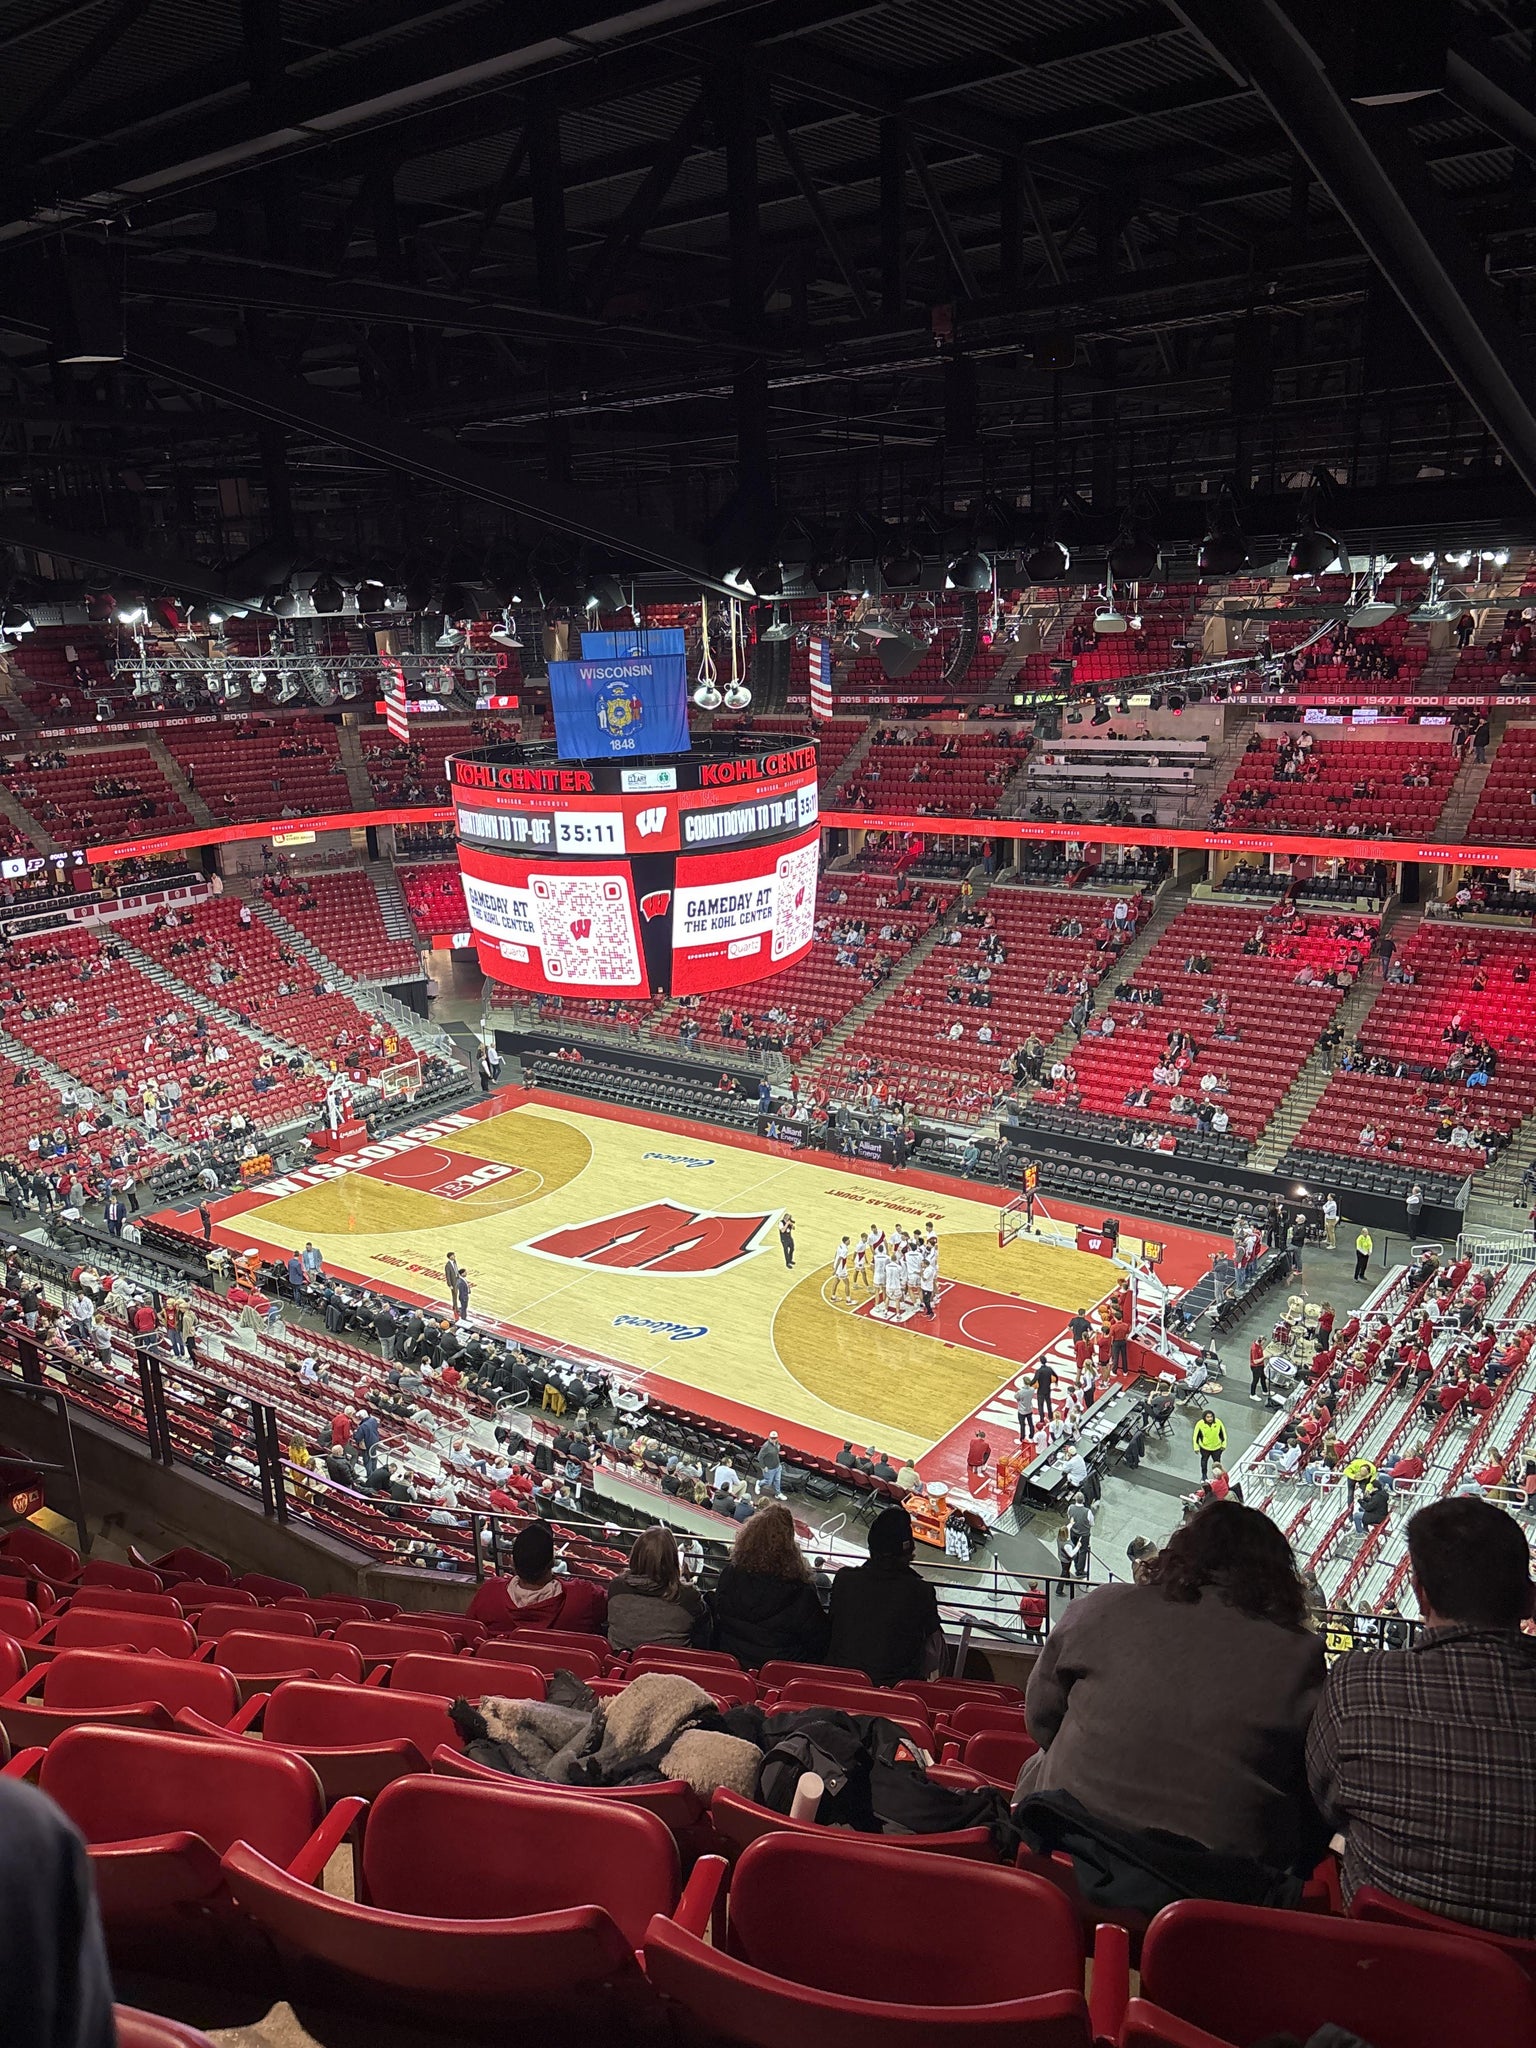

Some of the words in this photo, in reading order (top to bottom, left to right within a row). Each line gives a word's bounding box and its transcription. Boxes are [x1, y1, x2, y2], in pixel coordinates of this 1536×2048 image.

[580, 665, 653, 680] WISCONSIN
[1251, 695, 1282, 704] ELITE
[1288, 695, 1297, 704] 8
[1322, 696, 1351, 705] 1941
[1363, 696, 1394, 705] 1947
[1404, 696, 1438, 705] 2000
[1448, 696, 1484, 705] 2005
[1495, 696, 1531, 705] 2014
[194, 715, 218, 723] 2002
[223, 712, 249, 720] 2010
[106, 723, 130, 731] 1996
[136, 720, 160, 729] 1998
[166, 718, 188, 726] 2001
[40, 729, 66, 738] 1992
[73, 725, 98, 734] 1995
[610, 738, 636, 750] 1848
[701, 758, 763, 786] KOHL
[765, 746, 818, 775] CENTER
[456, 763, 496, 787] KOHL
[498, 768, 594, 792] CENTER
[800, 793, 817, 816] 35:11
[685, 804, 757, 842] COUNTDOWN
[757, 803, 769, 830] TO
[769, 797, 797, 828] TIP-OFF
[498, 815, 511, 841] TO
[512, 816, 550, 844] TIP-OFF
[560, 824, 615, 842] 35:11
[11, 864, 19, 872] 0
[56, 859, 65, 868] 0
[469, 887, 509, 915] GAMEDAY
[512, 901, 529, 918] AT
[687, 893, 753, 918] GAMEDAY
[756, 887, 772, 907] AT
[471, 906, 483, 921] THE
[484, 911, 502, 927] KOHL
[502, 917, 536, 934] CENTER
[684, 920, 708, 933] THE
[711, 915, 737, 930] KOHL
[739, 907, 773, 924] CENTER
[729, 940, 760, 956] Quartz
[781, 1126, 803, 1137] Alliant
[859, 1141, 882, 1152] Alliant
[251, 1113, 482, 1199] WISCONSIN
[824, 1188, 866, 1202] COURT
[865, 1198, 926, 1216] NICHOLAS
[925, 1211, 946, 1221] AB
[370, 1253, 409, 1268] COURT
[613, 1315, 709, 1341] Culver's
